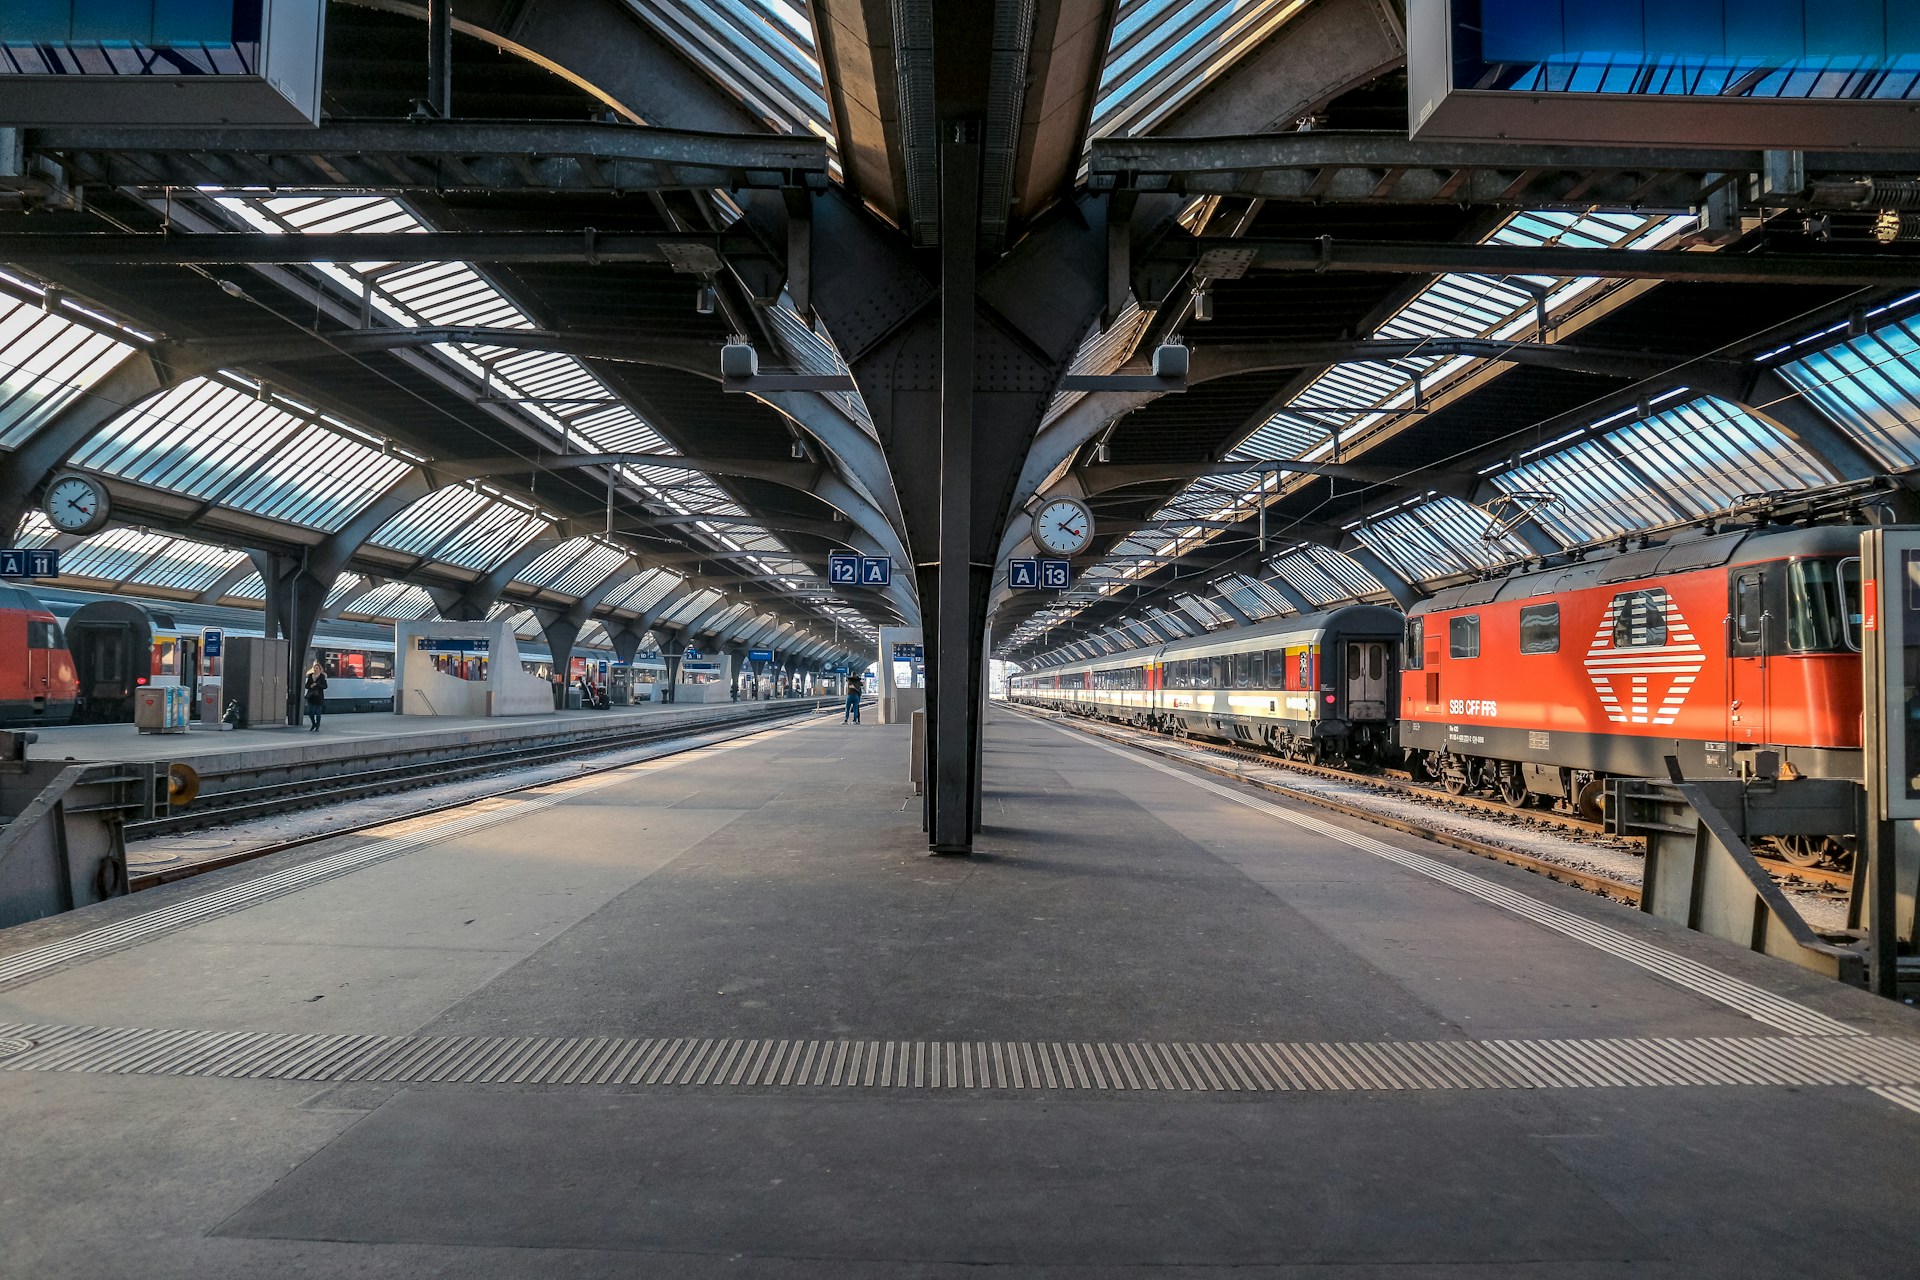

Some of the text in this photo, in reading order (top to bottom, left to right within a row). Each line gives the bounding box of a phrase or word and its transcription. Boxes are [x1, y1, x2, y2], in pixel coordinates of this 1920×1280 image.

[5, 558, 18, 573] A
[35, 558, 48, 573] 11
[834, 565, 853, 580] 12
[869, 566, 882, 581] A
[1016, 569, 1030, 583] A
[1046, 569, 1065, 584] 13
[1449, 700, 1497, 717] SBB CFF FFS
